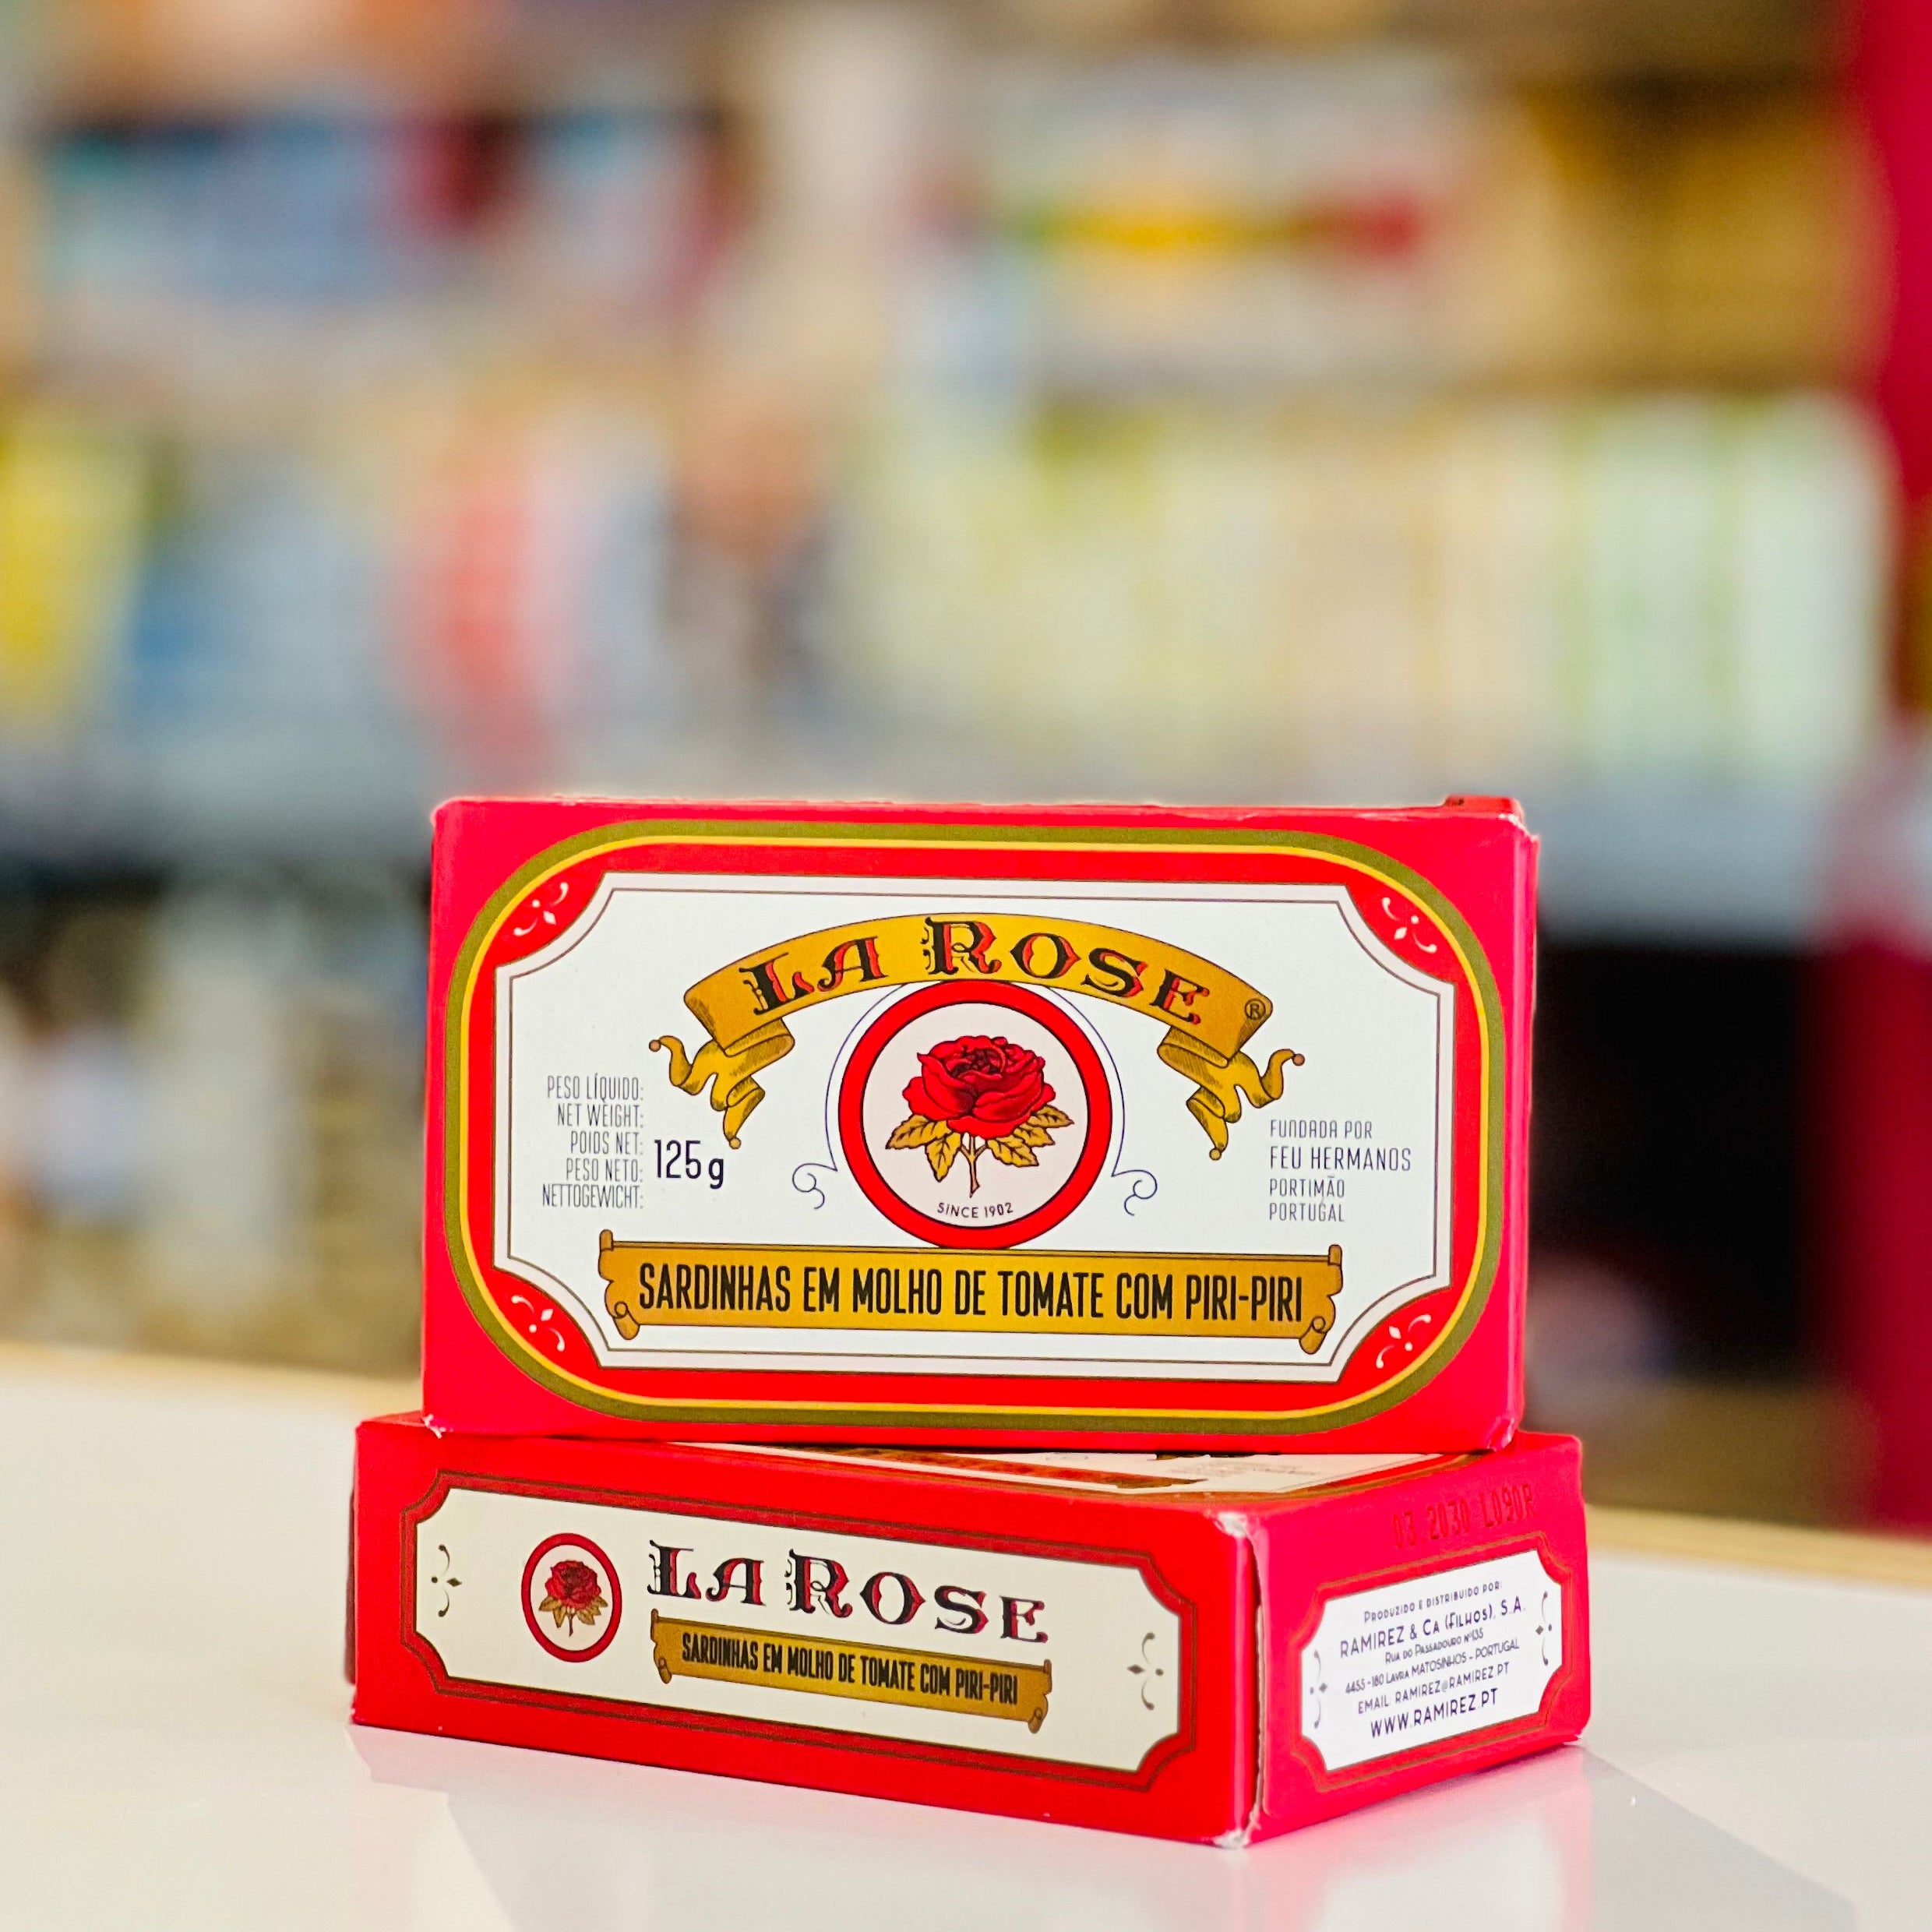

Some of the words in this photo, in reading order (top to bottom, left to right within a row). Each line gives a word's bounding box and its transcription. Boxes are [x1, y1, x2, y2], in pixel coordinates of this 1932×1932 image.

[739, 936, 888, 1014] LA
[920, 917, 1211, 1024] ROSE
[547, 1075, 580, 1098] PESO
[586, 1073, 643, 1103] LÍQUIDO:
[557, 1103, 582, 1126] NET
[587, 1104, 643, 1128] WEIGHT:
[1270, 1119, 1338, 1139] FUNDADA
[1345, 1120, 1373, 1139] POR
[570, 1130, 610, 1155] POIDS
[615, 1131, 643, 1155] NET:
[566, 1158, 599, 1181] PESO
[605, 1158, 643, 1183] NETO:
[1270, 1146, 1302, 1169] FEU
[1311, 1147, 1412, 1172] HERMANOS
[542, 1183, 643, 1209] NETTOGEWICHT:
[1269, 1176, 1345, 1198] PORTIMÃO
[937, 1202, 978, 1218] SINCE
[984, 1202, 1014, 1218] 1902
[1269, 1202, 1345, 1222] PORTUGAL
[639, 1263, 791, 1312] SARDINHAS
[803, 1266, 840, 1313] EM
[852, 1267, 942, 1315] MOLHO
[954, 1269, 986, 1316] DE
[997, 1271, 1105, 1318] TOMATE
[1116, 1272, 1173, 1320] COM
[1186, 1274, 1303, 1323] PIRI-PIRI
[647, 1539, 767, 1606] LA
[784, 1549, 1048, 1644] ROSE
[1340, 1625, 1405, 1659] RAMIREZ
[1409, 1624, 1418, 1640] &
[682, 1632, 759, 1671] SARDINHAS
[763, 1643, 783, 1674] EM
[788, 1646, 834, 1681] MOLHO
[838, 1652, 856, 1683] DE
[860, 1655, 915, 1691] TOMATE
[920, 1663, 950, 1696] COM
[955, 1668, 1018, 1705] PIRI-PIRI
[1411, 1652, 1467, 1677] MATOSINHOS
[1475, 1636, 1520, 1660] PORTUGAL
[1370, 1687, 1498, 1738] WWW.RAMIREZ.PT
